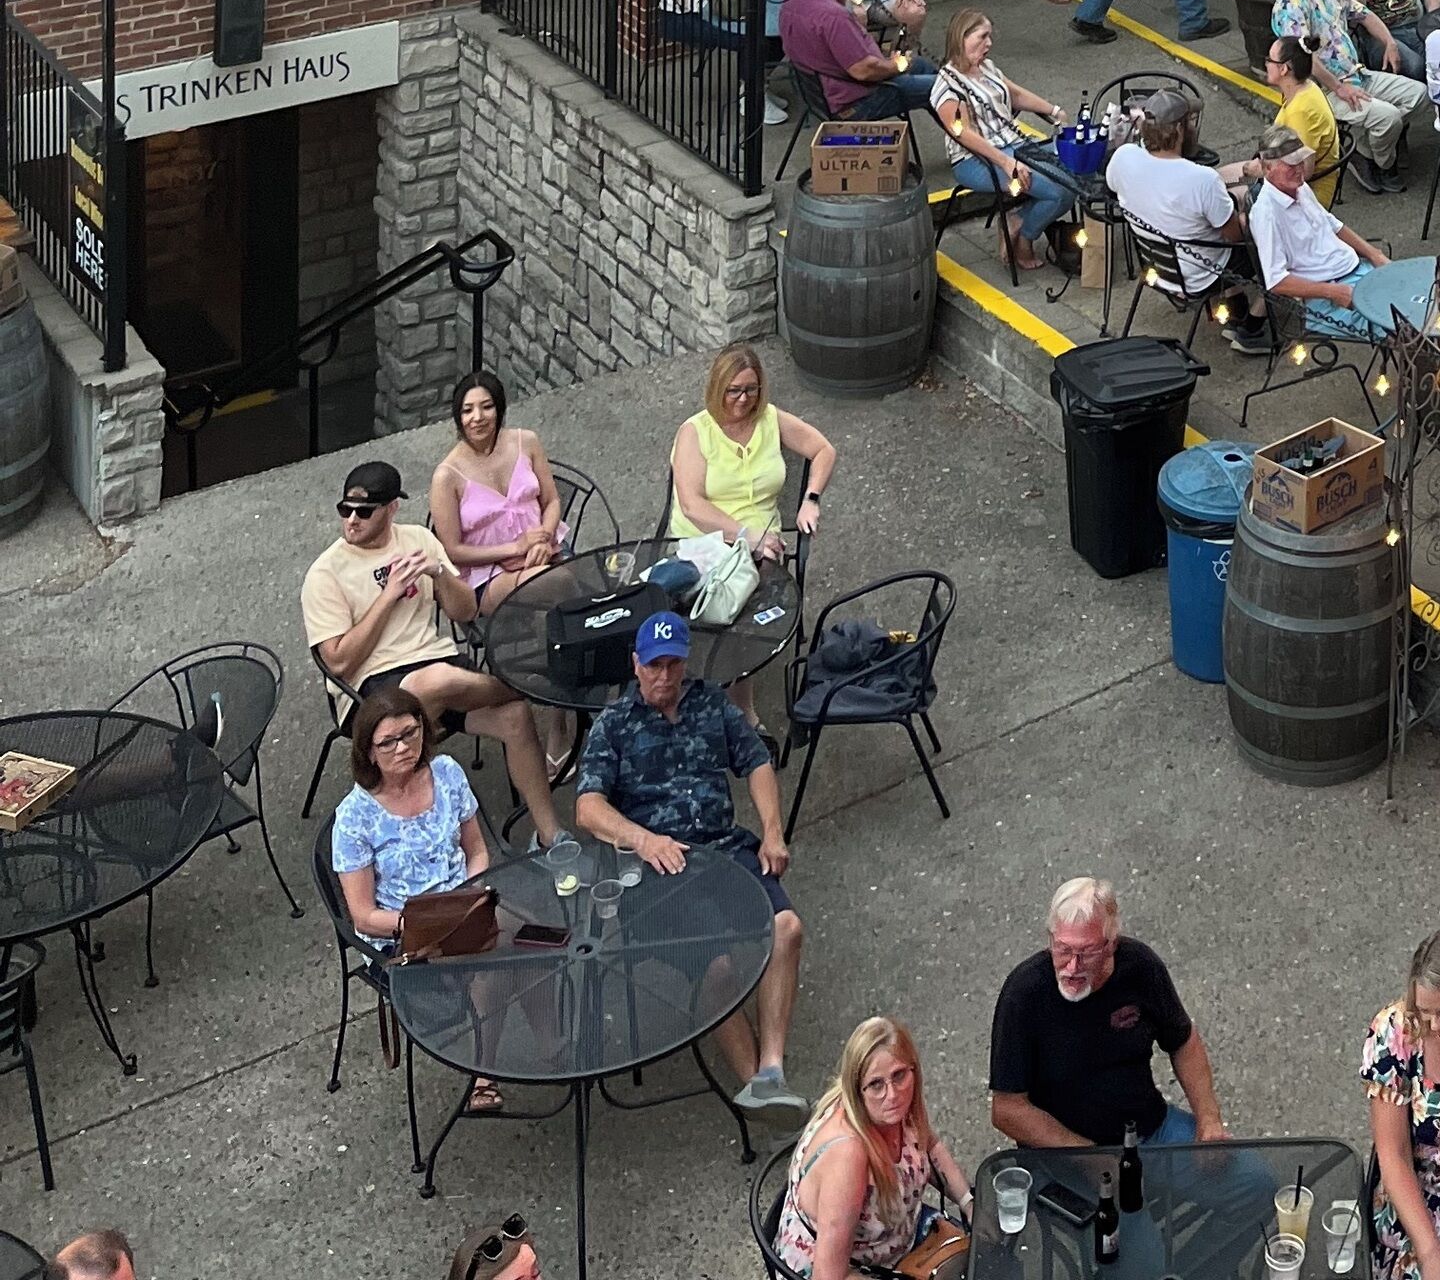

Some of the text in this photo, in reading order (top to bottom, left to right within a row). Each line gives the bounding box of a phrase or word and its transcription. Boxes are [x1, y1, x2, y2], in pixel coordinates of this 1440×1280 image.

[139, 65, 273, 114] TRINKEN
[283, 50, 351, 83] HAUS
[820, 156, 894, 172] ULTRA 4
[75, 248, 104, 290] HERE
[1261, 481, 1295, 510] BUSCH
[1316, 480, 1357, 513] BUSCH
[653, 621, 672, 640] KC
